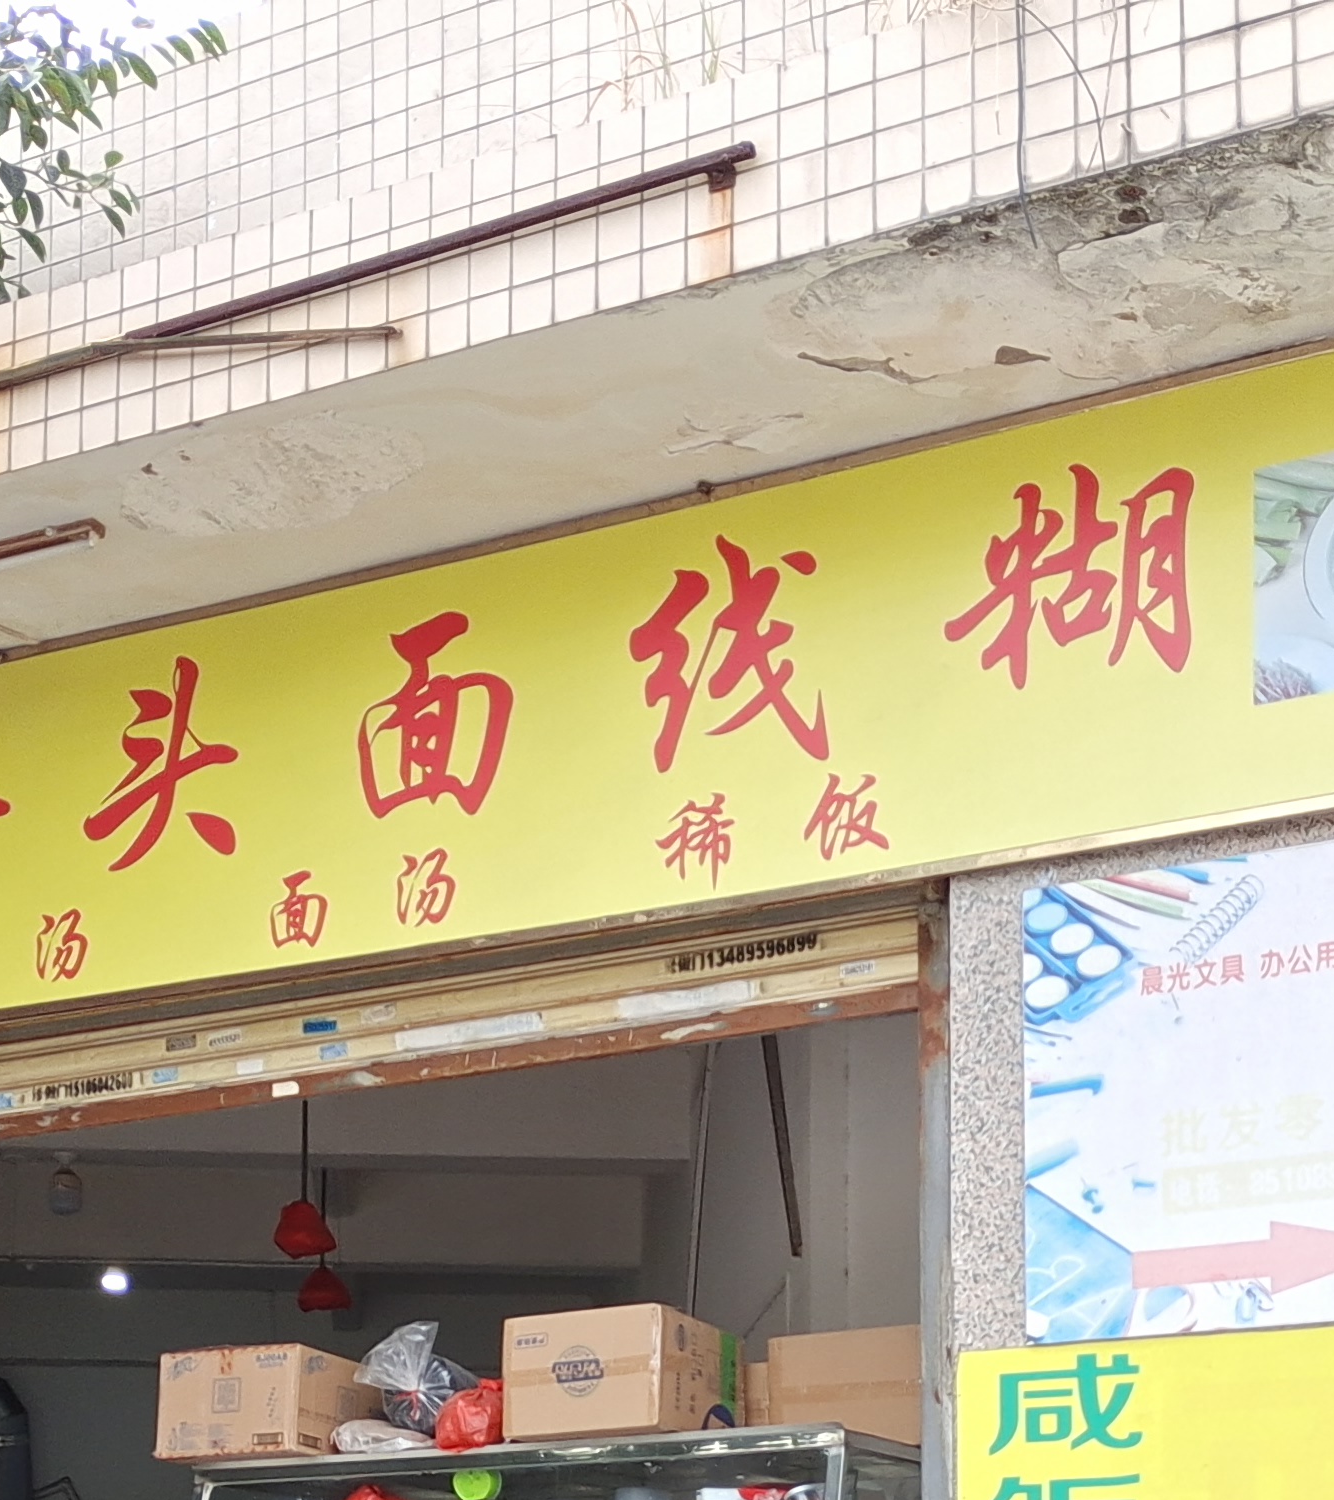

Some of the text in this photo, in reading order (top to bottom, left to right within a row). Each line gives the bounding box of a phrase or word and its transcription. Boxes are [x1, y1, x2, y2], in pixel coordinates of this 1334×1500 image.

[268, 848, 456, 949] 面汤
[654, 772, 890, 890] 稀饭
[1140, 954, 1245, 996] 晨光文具
